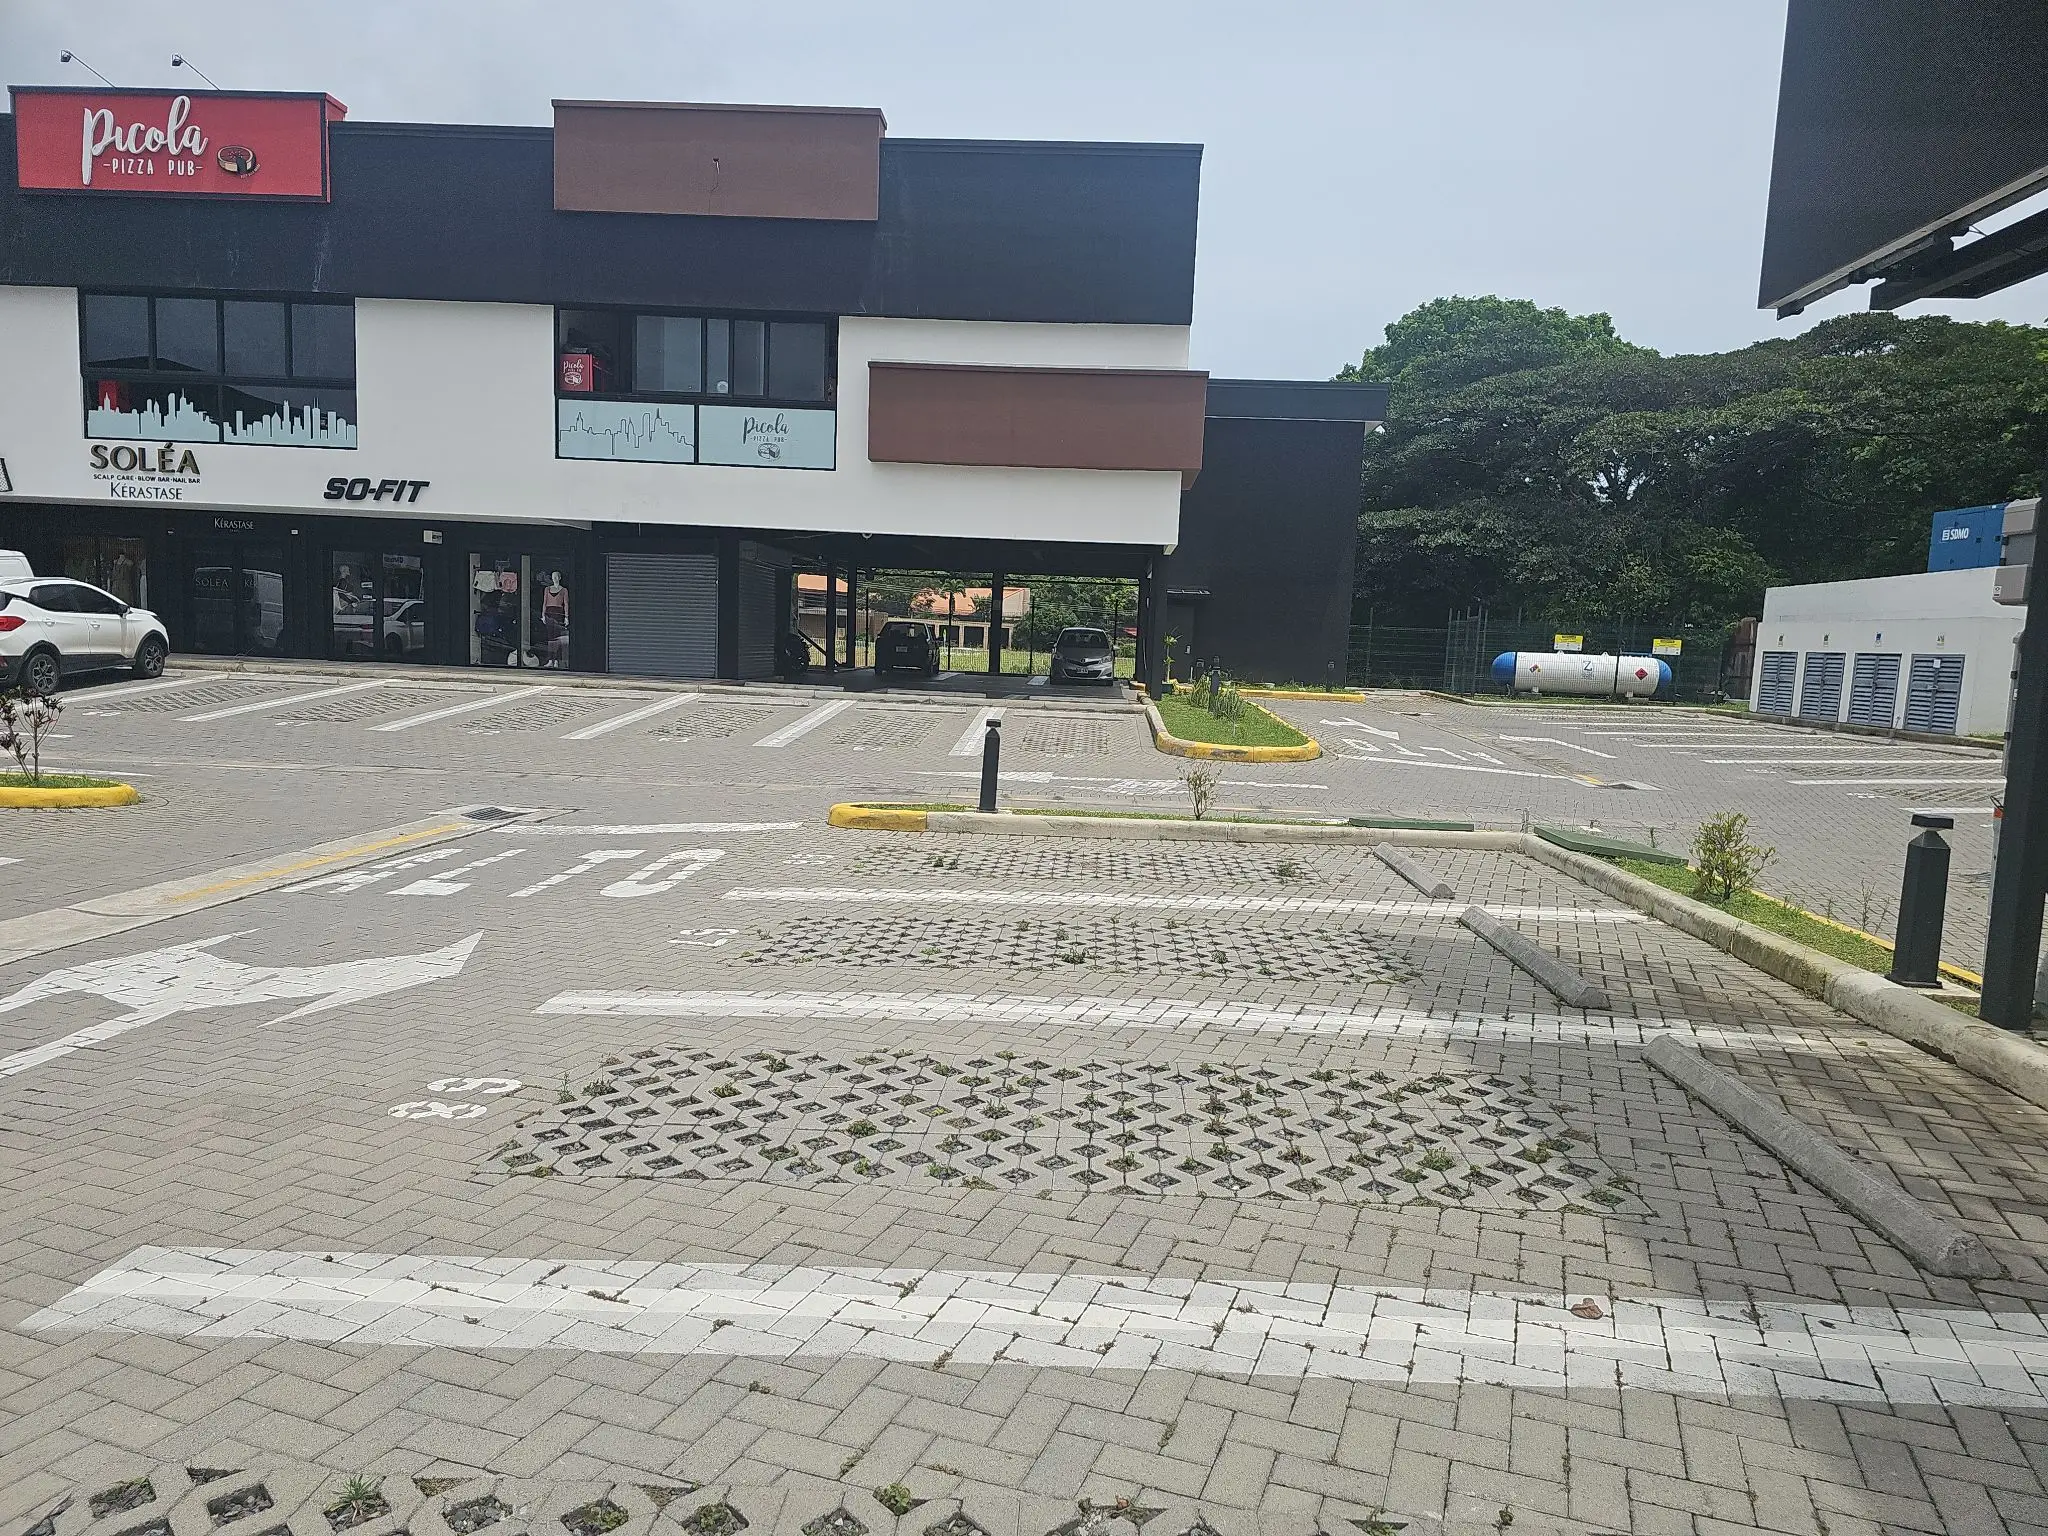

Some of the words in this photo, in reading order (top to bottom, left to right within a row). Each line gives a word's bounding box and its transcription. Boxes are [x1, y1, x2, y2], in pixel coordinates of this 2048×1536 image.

[82, 95, 208, 185] Picola
[743, 413, 789, 444] Picola
[90, 442, 200, 475] SOLÉA
[110, 482, 183, 500] KÉRASTASE
[324, 478, 430, 502] SO-FIT
[280, 848, 725, 897] ALTO
[387, 1077, 522, 1120] 68
